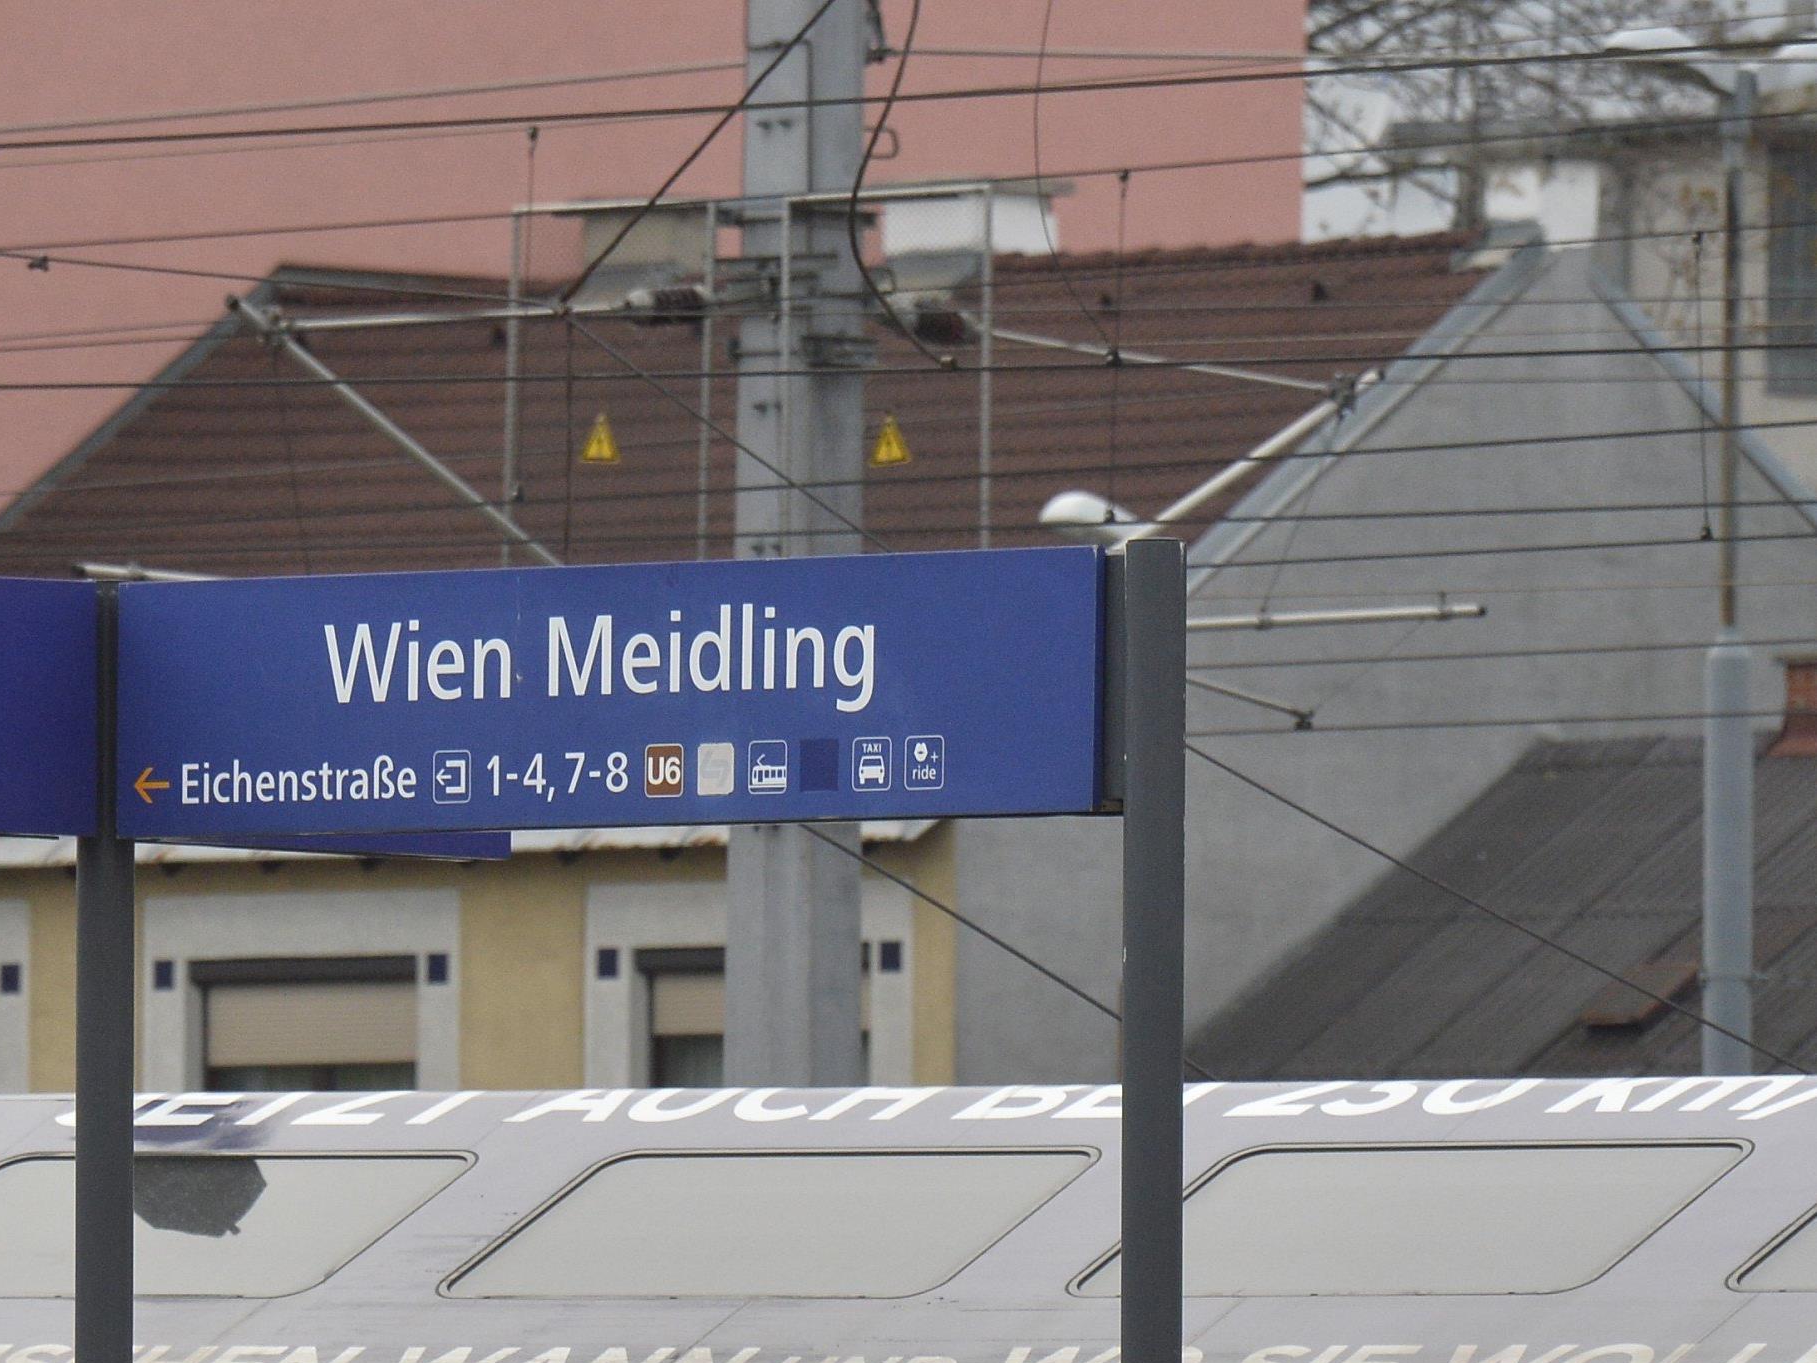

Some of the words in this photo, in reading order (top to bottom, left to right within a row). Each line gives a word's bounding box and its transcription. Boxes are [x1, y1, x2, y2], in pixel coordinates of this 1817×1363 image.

[324, 618, 512, 704] Wien
[548, 603, 875, 713] Meidling
[862, 743, 882, 754] TAXI
[181, 754, 417, 805] Eichenstraße
[647, 756, 681, 785] U6
[912, 764, 937, 780] ride
